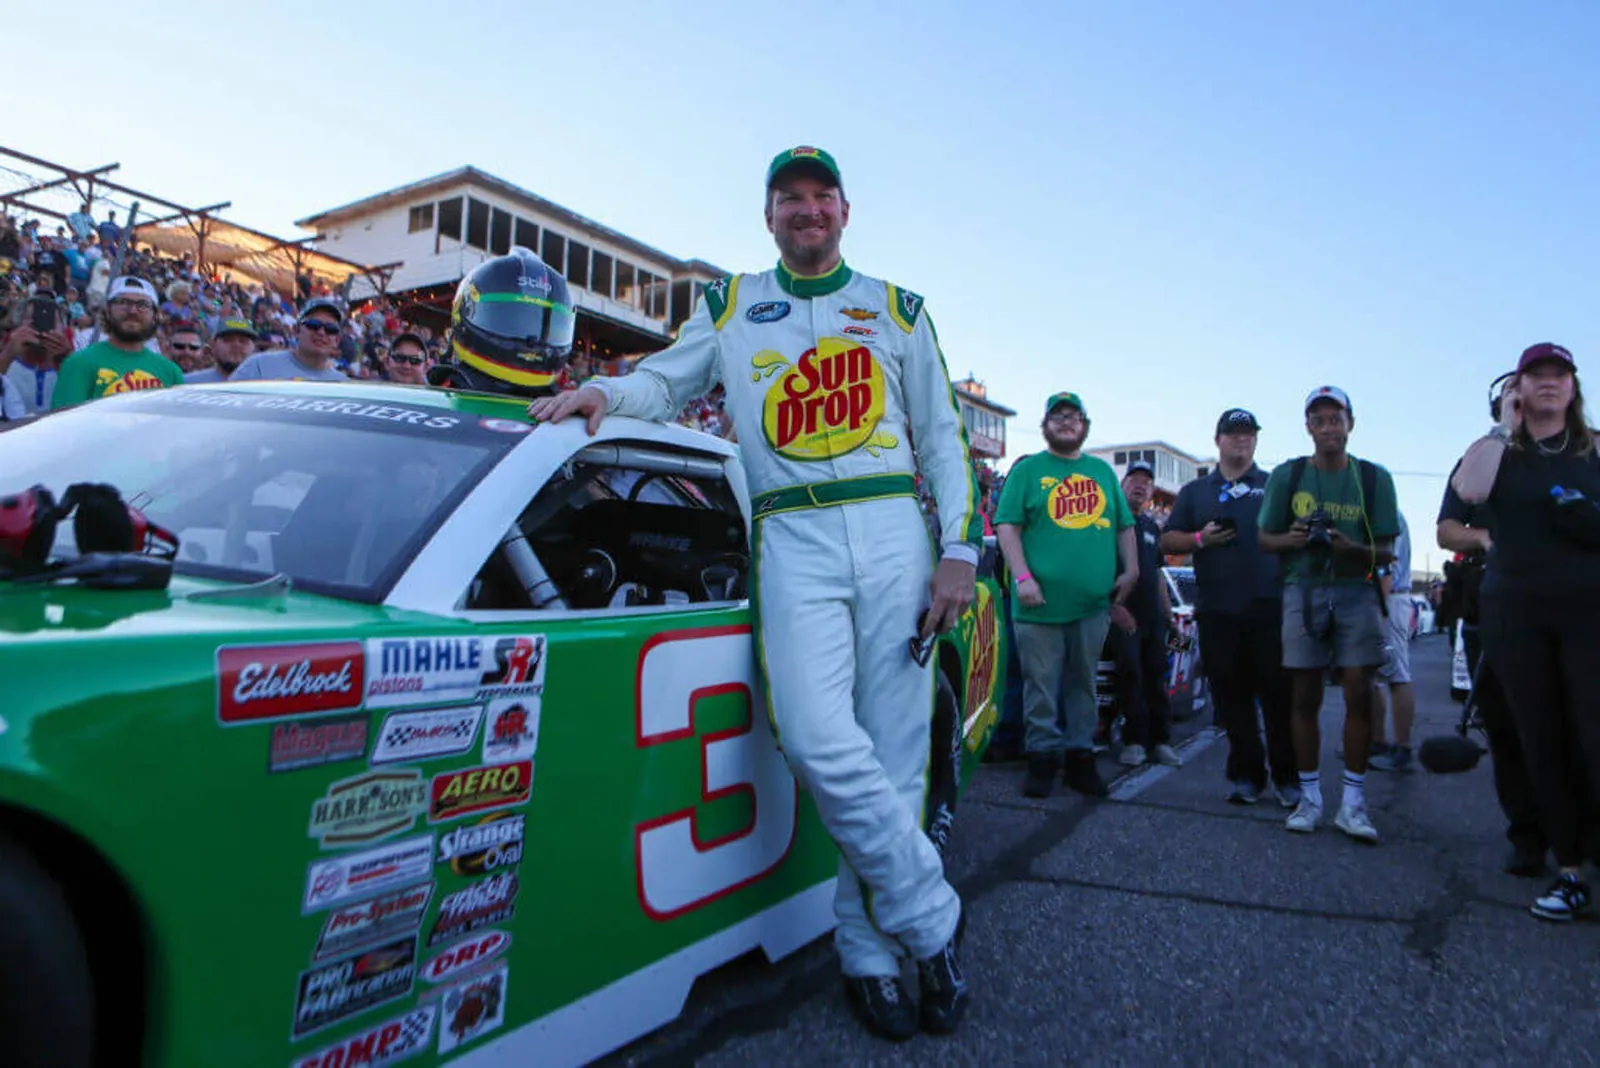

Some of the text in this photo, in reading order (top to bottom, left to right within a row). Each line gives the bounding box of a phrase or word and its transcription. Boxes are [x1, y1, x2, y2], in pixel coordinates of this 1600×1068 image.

[784, 346, 872, 401] Sun
[256, 397, 460, 430] CARRIERS
[776, 382, 872, 449] Drop
[1057, 475, 1097, 497] Sun
[1054, 493, 1099, 520] Drop
[382, 639, 481, 674] MAHLE
[234, 660, 352, 703] Edelbrock
[440, 764, 521, 799] AERO
[634, 623, 799, 923] 3
[432, 932, 502, 977] DRP
